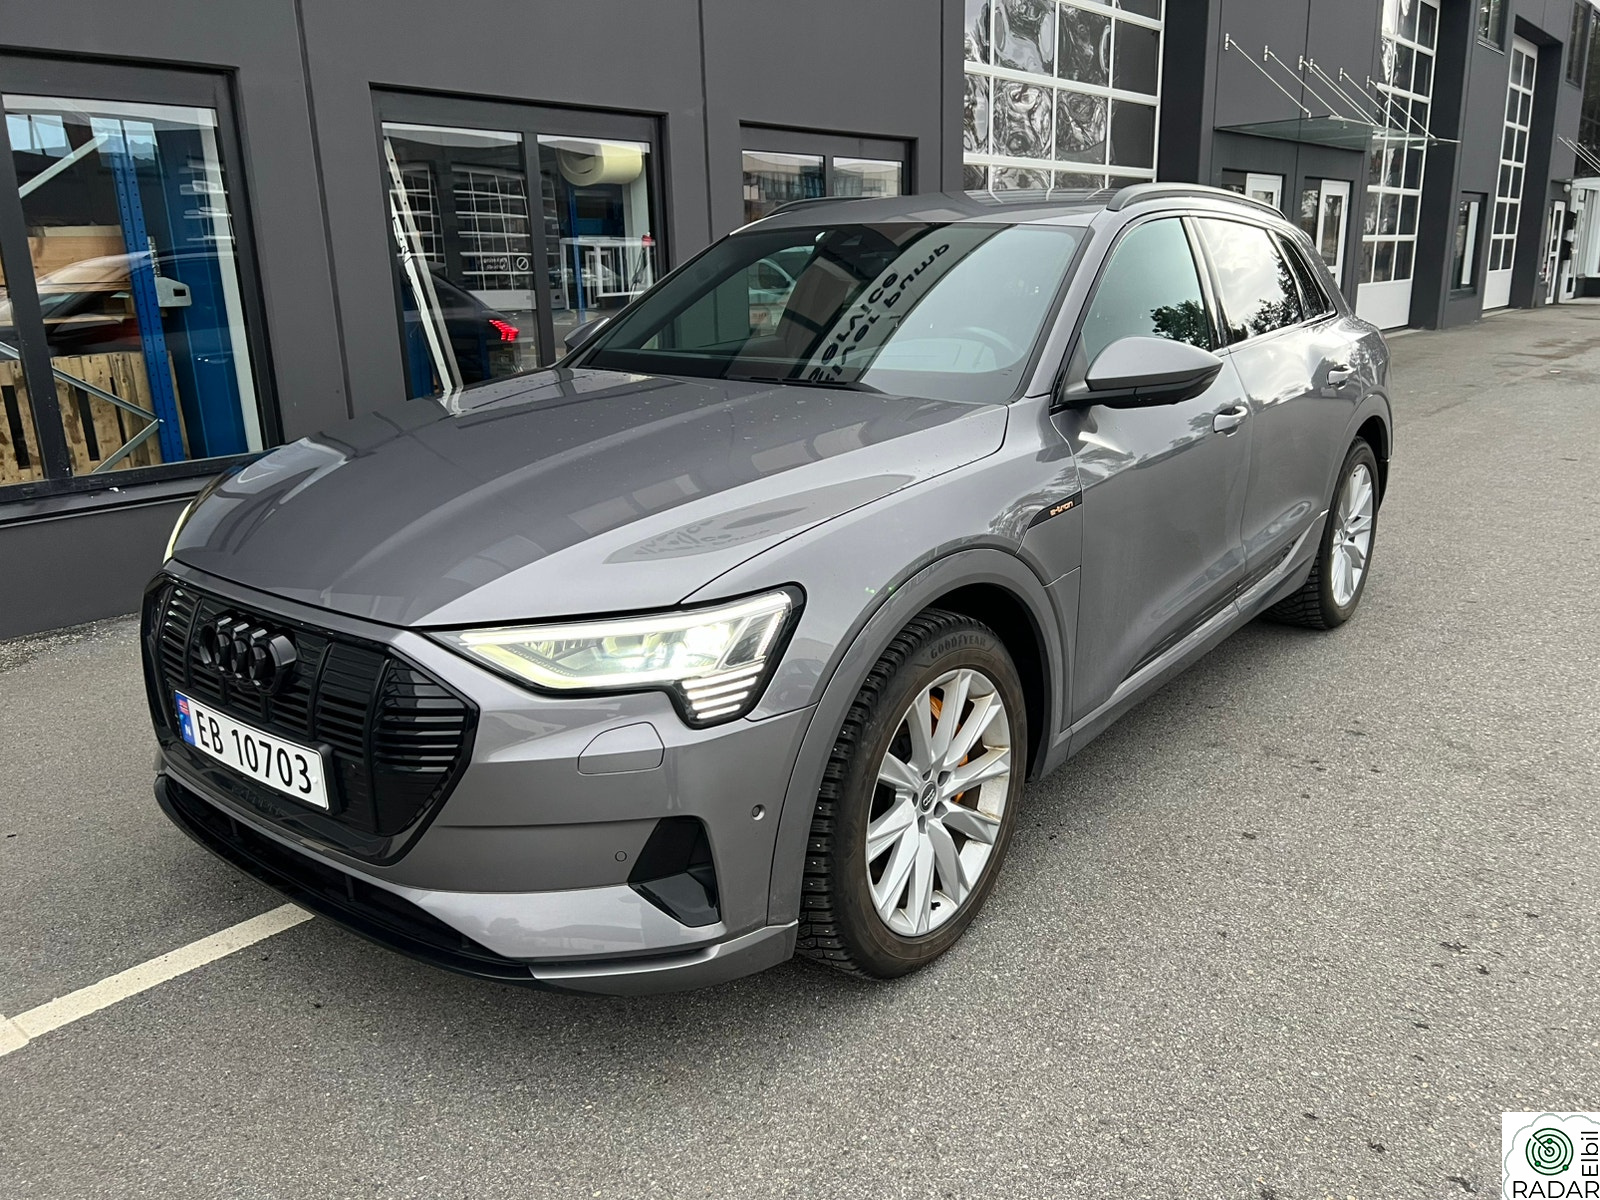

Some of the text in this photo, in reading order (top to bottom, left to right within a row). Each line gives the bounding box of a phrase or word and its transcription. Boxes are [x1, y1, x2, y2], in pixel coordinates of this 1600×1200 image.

[1050, 500, 1074, 517] e-tron
[930, 634, 987, 660] GOODYEAR
[195, 709, 312, 794] EB 10703
